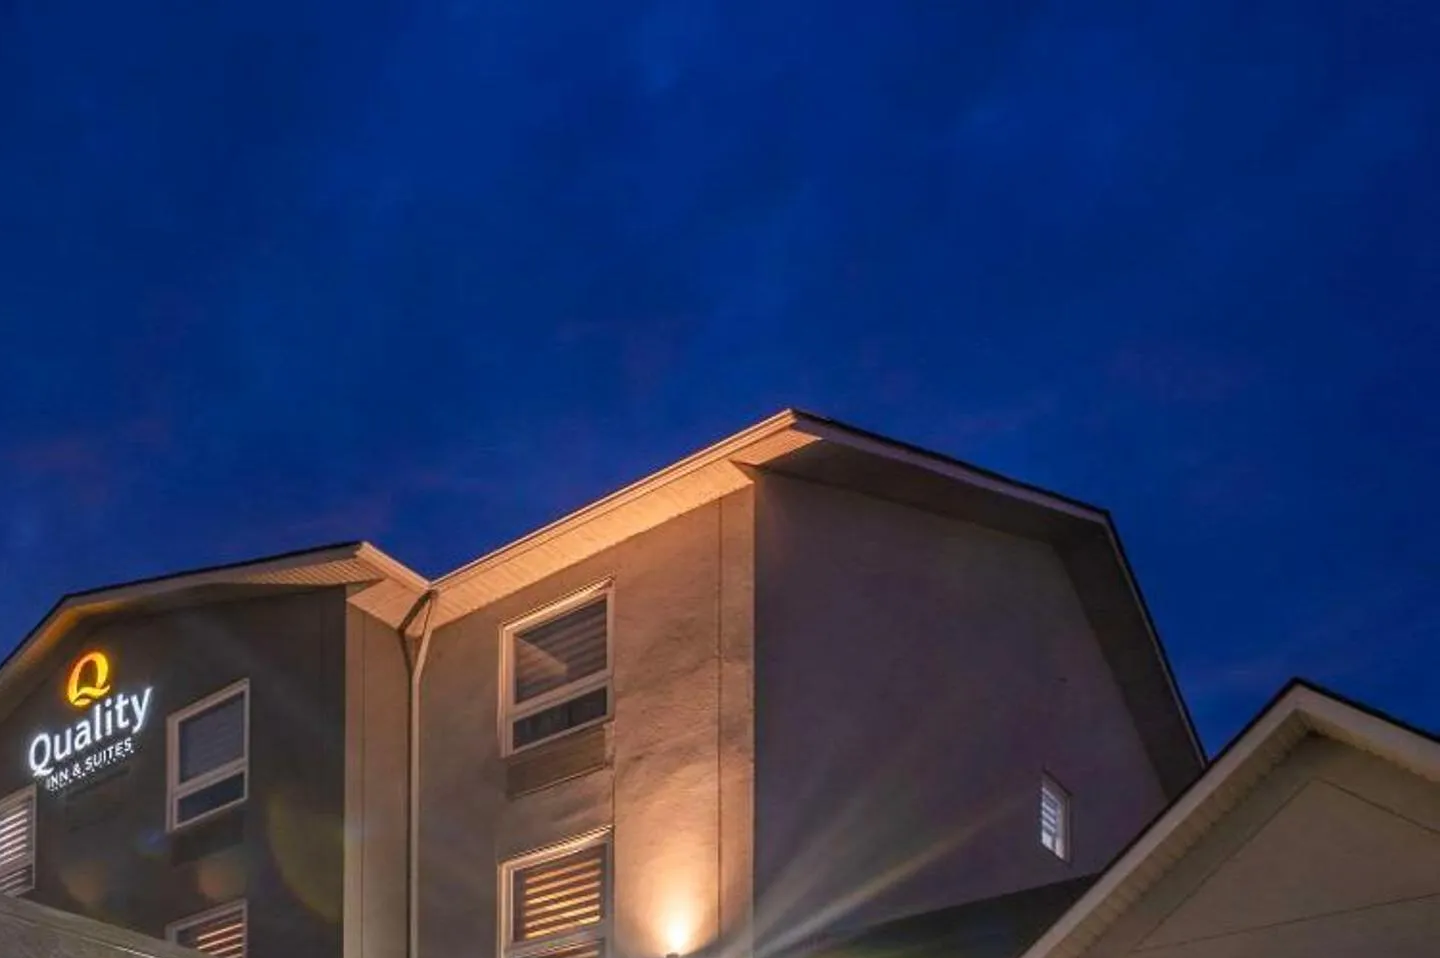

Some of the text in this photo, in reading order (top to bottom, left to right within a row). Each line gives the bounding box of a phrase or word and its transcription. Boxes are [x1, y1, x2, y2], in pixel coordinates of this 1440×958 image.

[29, 686, 153, 777] Quality
[45, 737, 133, 791] INN & SUITES
